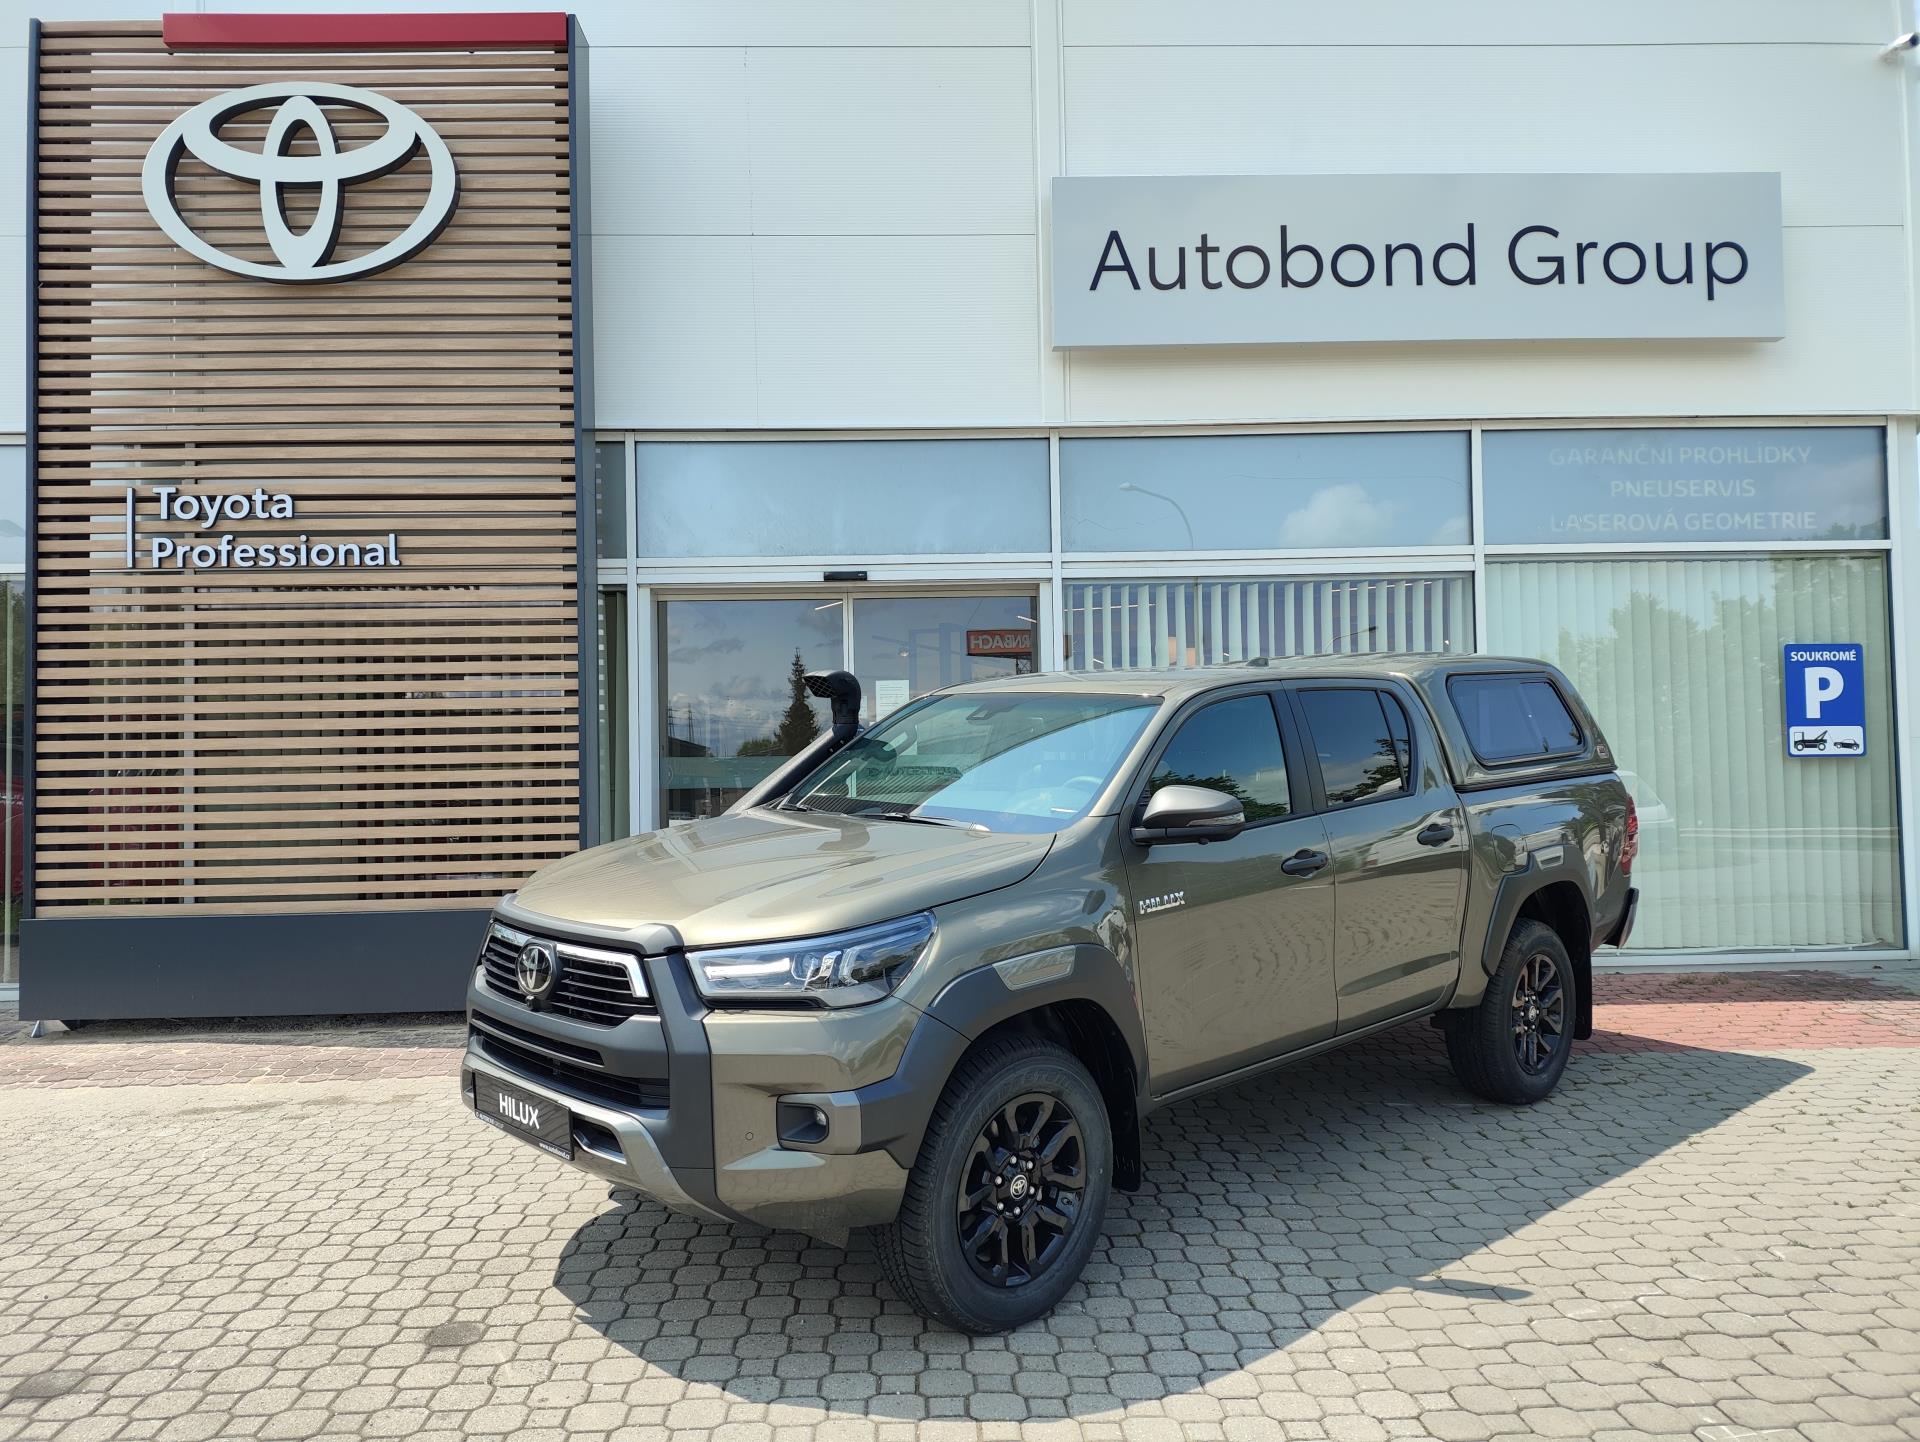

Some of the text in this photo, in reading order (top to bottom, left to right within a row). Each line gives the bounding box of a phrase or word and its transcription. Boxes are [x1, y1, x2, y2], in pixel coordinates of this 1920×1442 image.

[1089, 222, 1749, 301] Autobond Group
[1679, 441, 1811, 464] PROHLÍDKY
[1611, 478, 1756, 498] PNEUSERVIS
[152, 486, 294, 530] Toyota
[1551, 508, 1817, 532] LASEROVÁ GEOMETRIE
[152, 533, 401, 568] Professional
[1790, 649, 1857, 662] SOUKROMÉ
[1804, 666, 1845, 719] P
[1139, 890, 1186, 915] HILUX
[498, 1092, 540, 1130] HILUX
